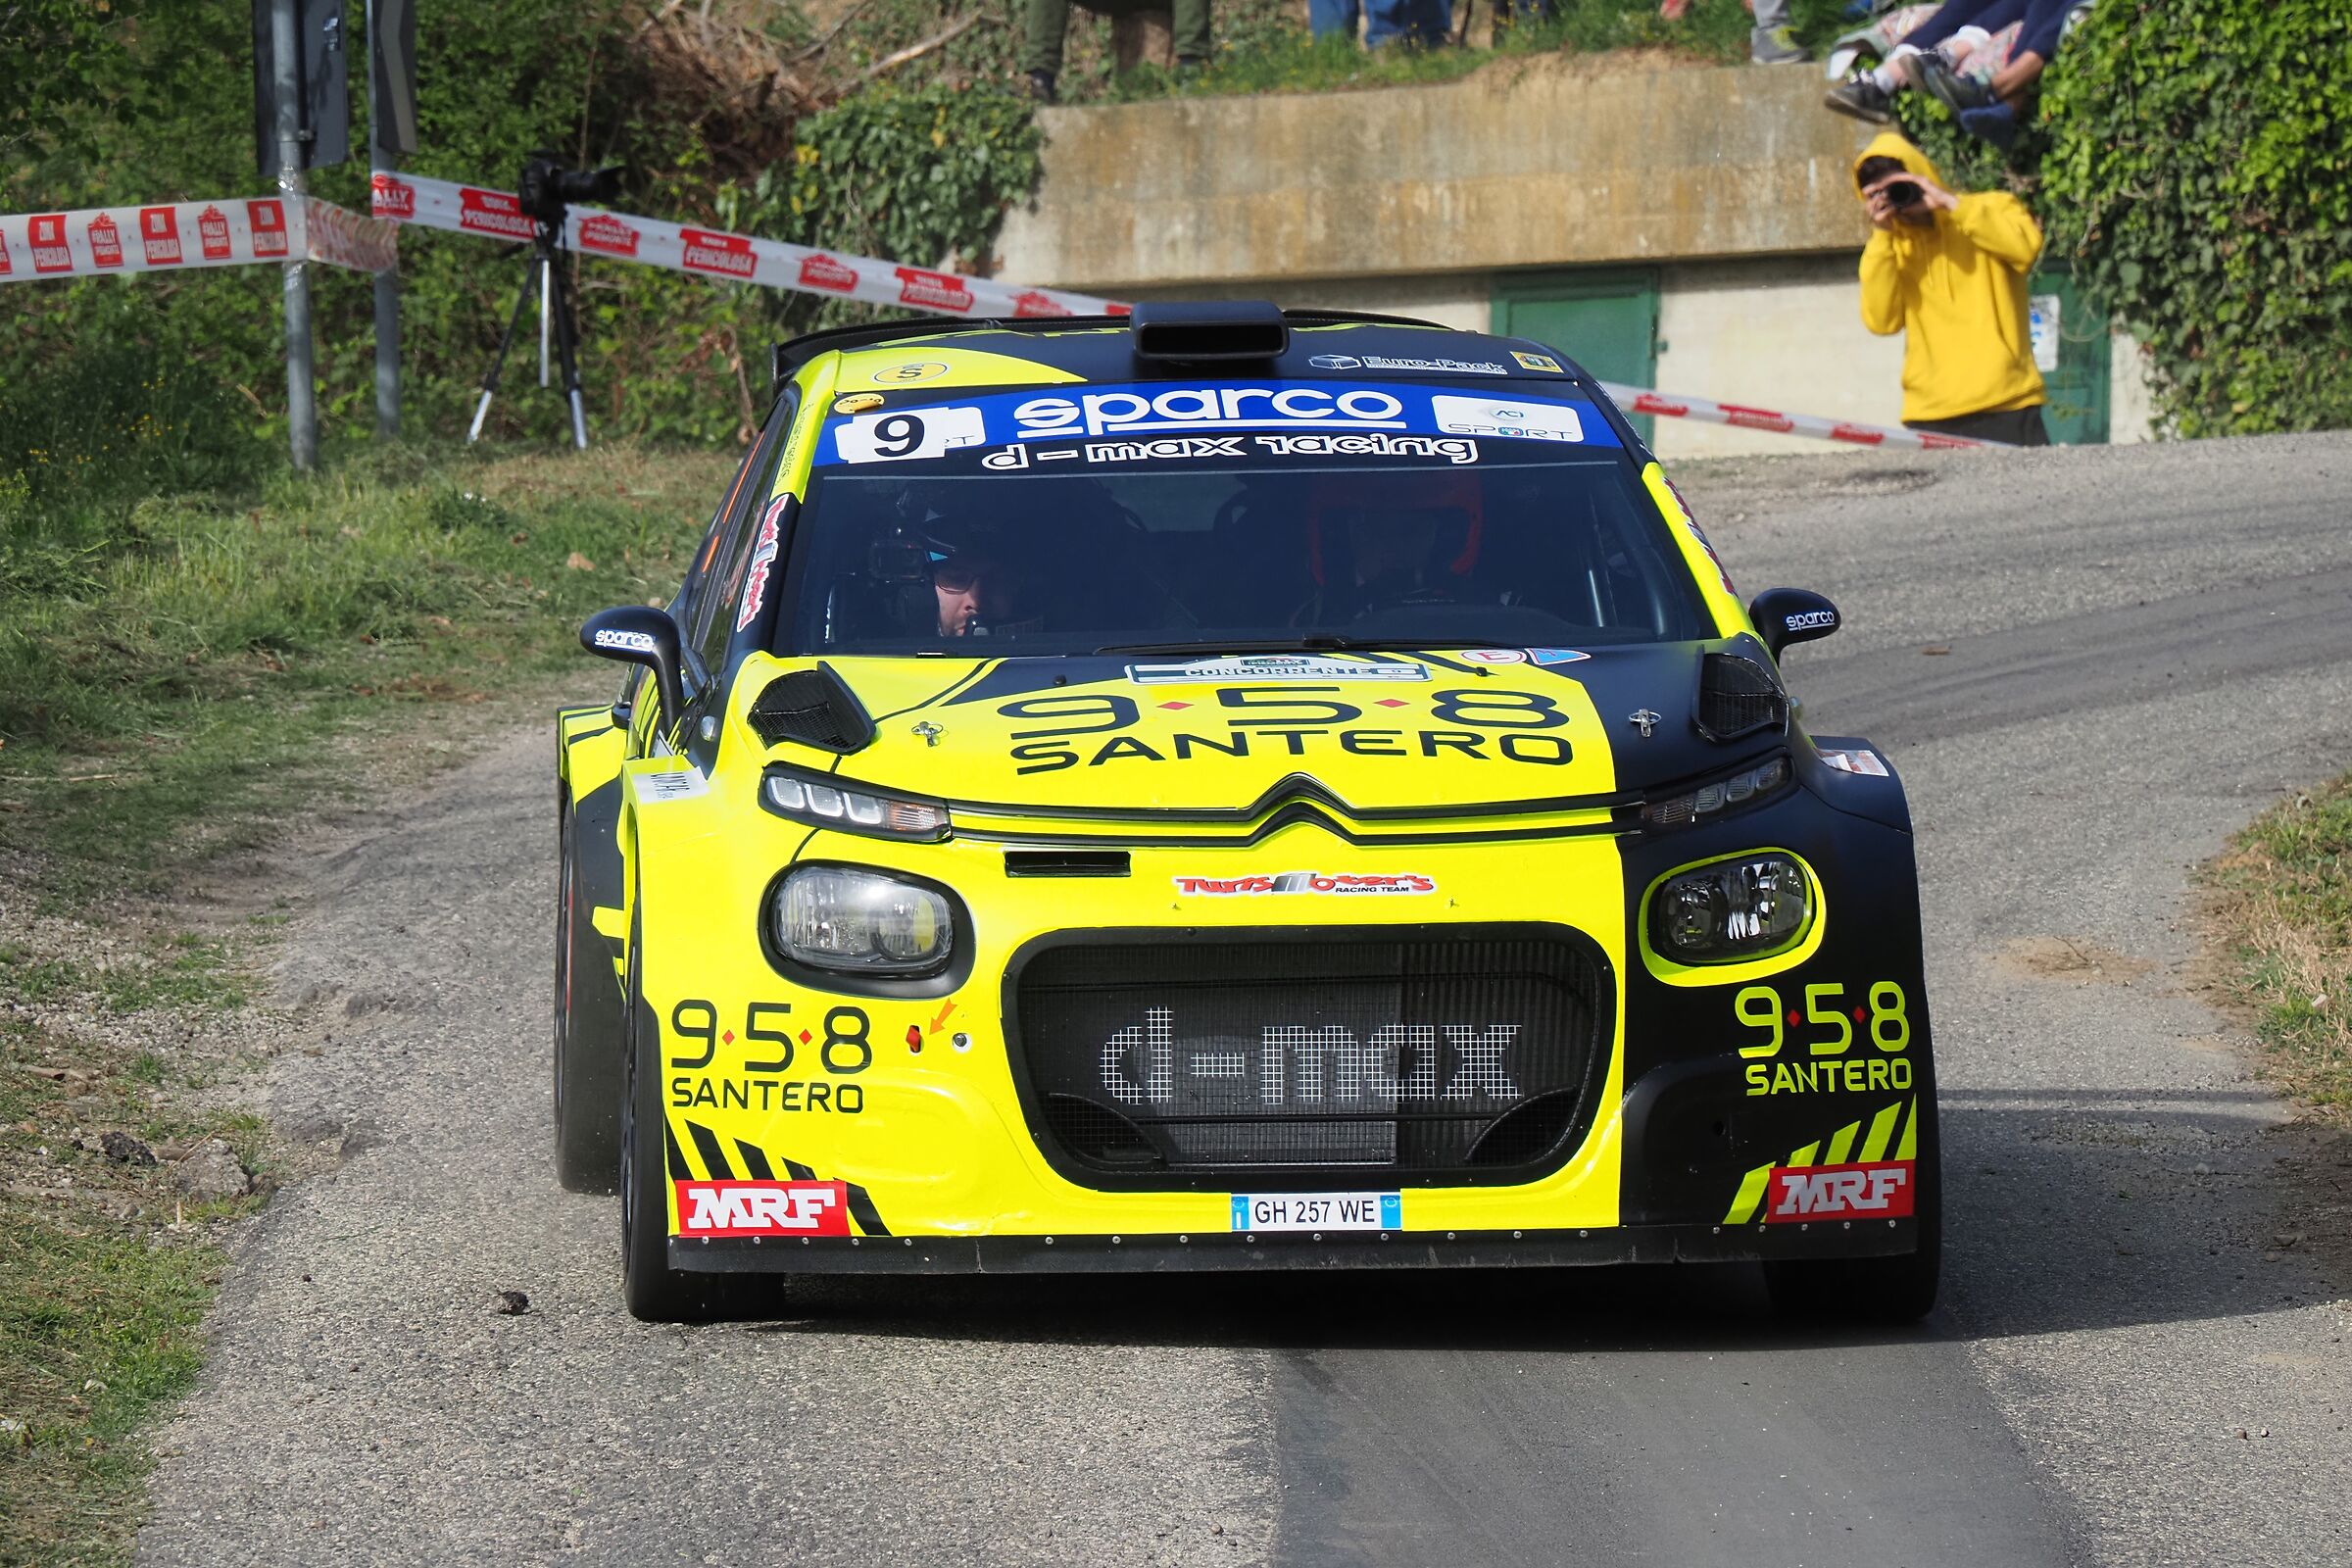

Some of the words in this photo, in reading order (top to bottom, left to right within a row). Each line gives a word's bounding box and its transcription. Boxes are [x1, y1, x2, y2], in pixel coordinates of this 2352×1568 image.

[1013, 389, 1404, 436] sparco
[874, 415, 925, 458] 9
[1255, 433, 1479, 465] racing
[1787, 610, 1836, 630] sparco
[594, 629, 655, 652] sparco
[1185, 666, 1372, 676] CONCORRENTE
[1010, 730, 1574, 775] SANTERO
[672, 1077, 863, 1114] SANTERO
[1745, 1058, 1912, 1096] SANTERO
[688, 1188, 836, 1229] MRF
[1776, 1168, 1906, 1215] MRF
[1254, 1200, 1287, 1224] GH
[1296, 1200, 1331, 1223] 257
[1339, 1200, 1375, 1223] WE
